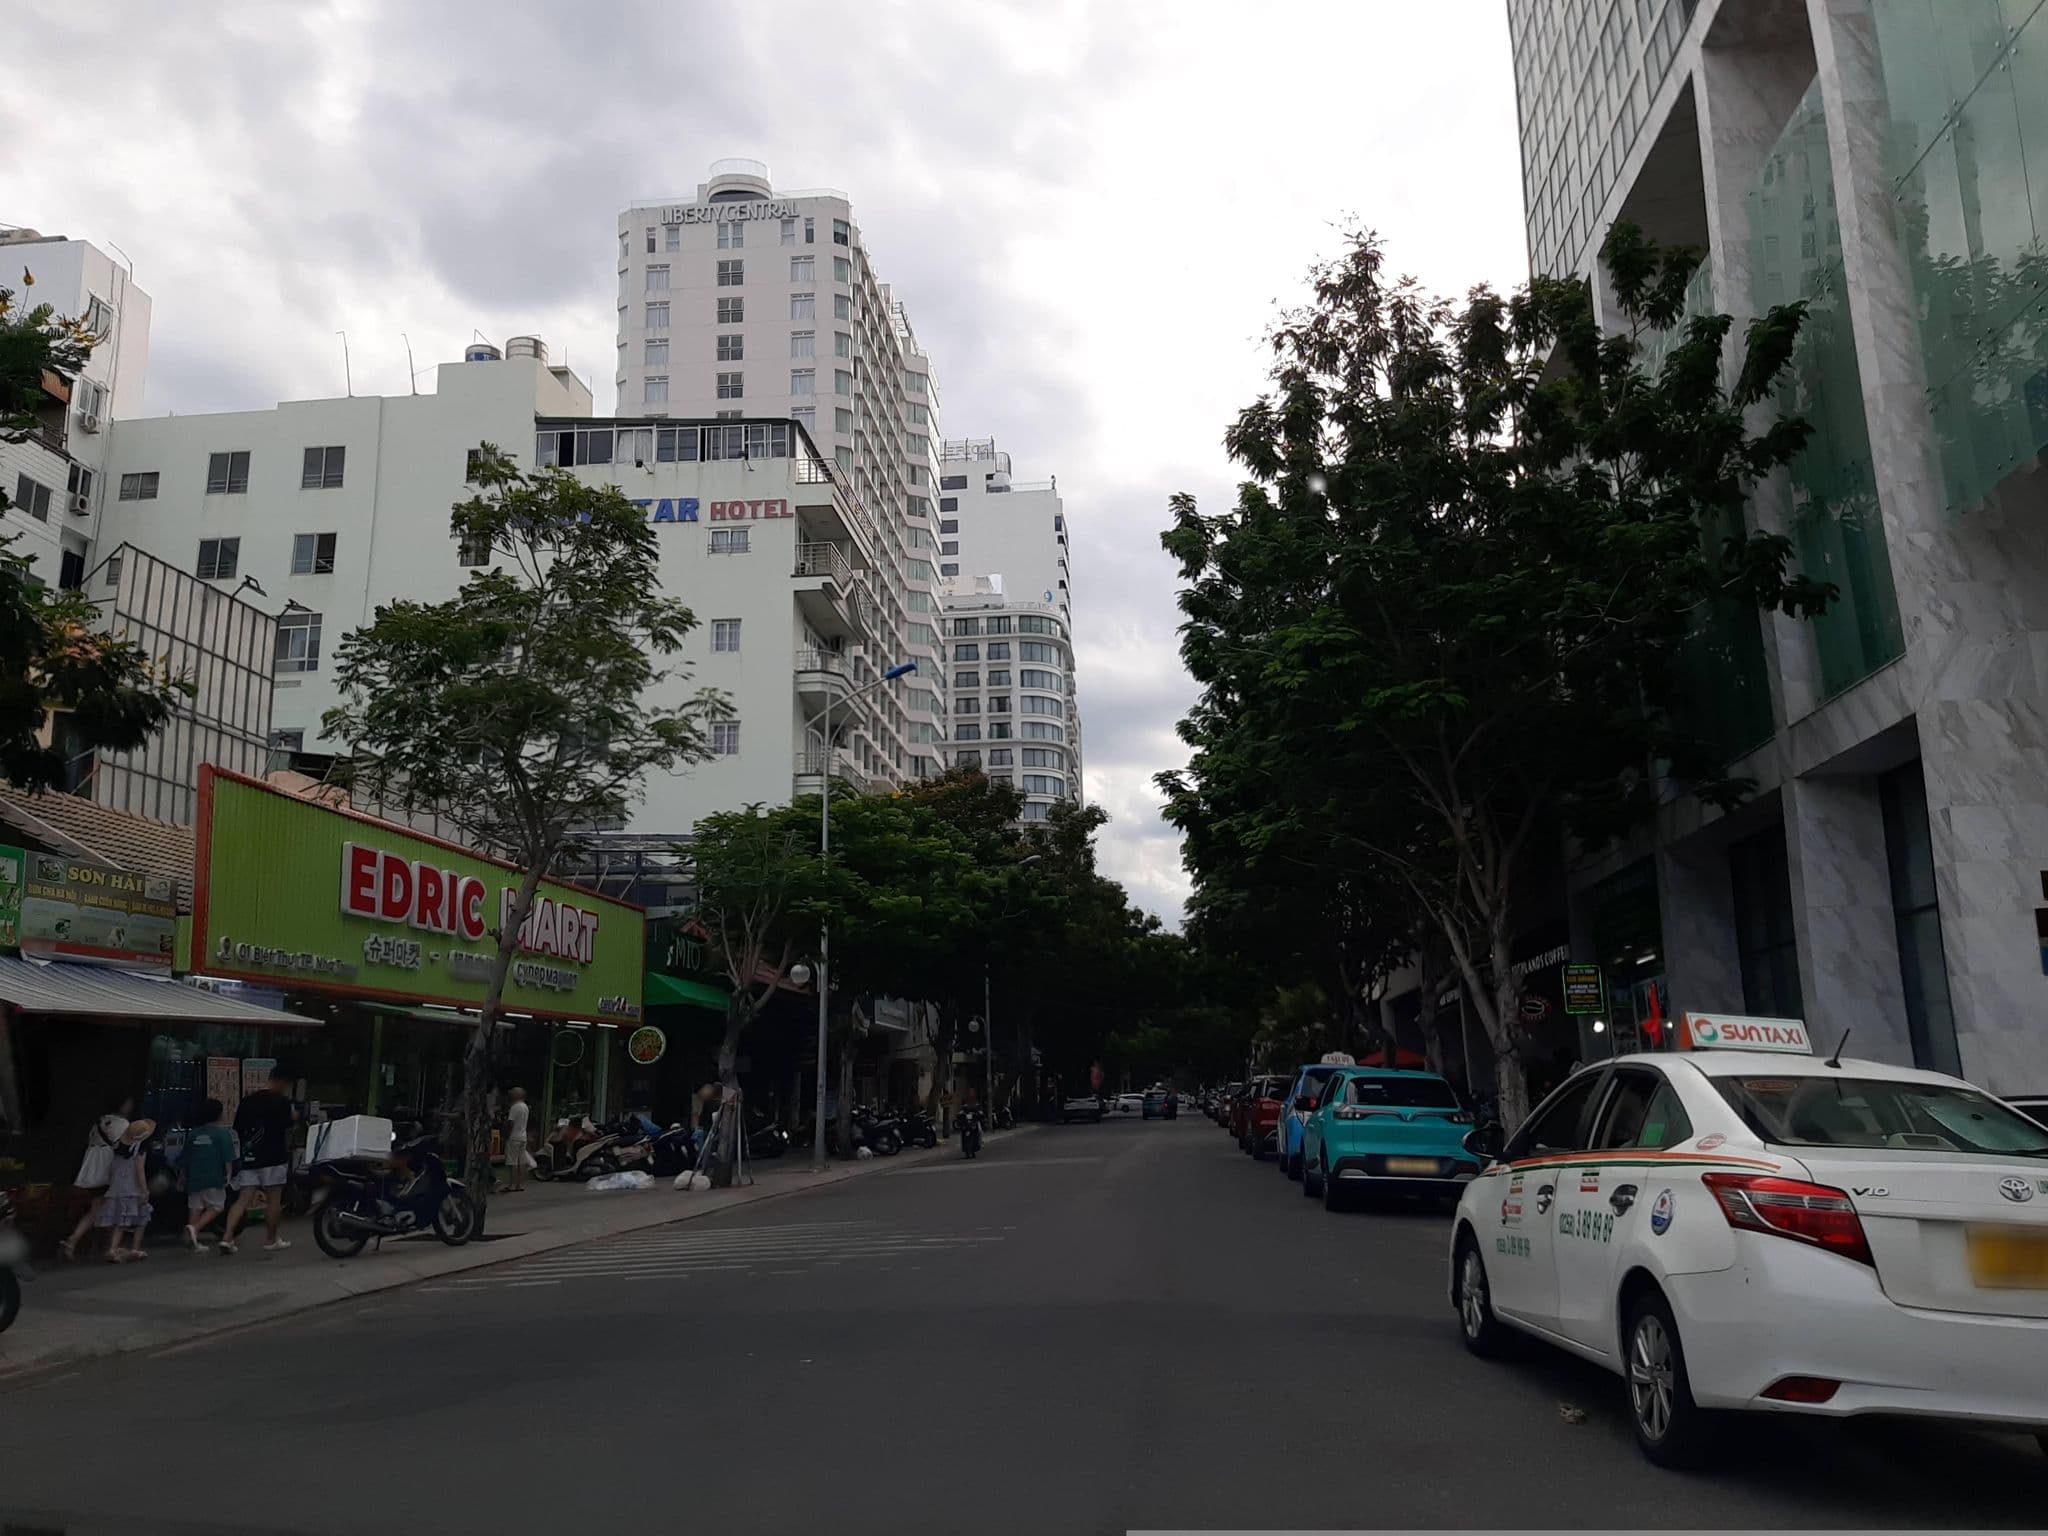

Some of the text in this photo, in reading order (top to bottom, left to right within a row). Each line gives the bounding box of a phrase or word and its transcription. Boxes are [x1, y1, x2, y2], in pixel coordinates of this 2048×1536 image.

[660, 202, 800, 225] LIBERTY CENTRAL
[628, 498, 794, 523] TAR HOTEL
[67, 866, 144, 892] SƠN HẢI
[343, 842, 488, 941] EDRIC
[366, 934, 422, 968] 슈퍼마켓
[516, 963, 578, 986] суперма
